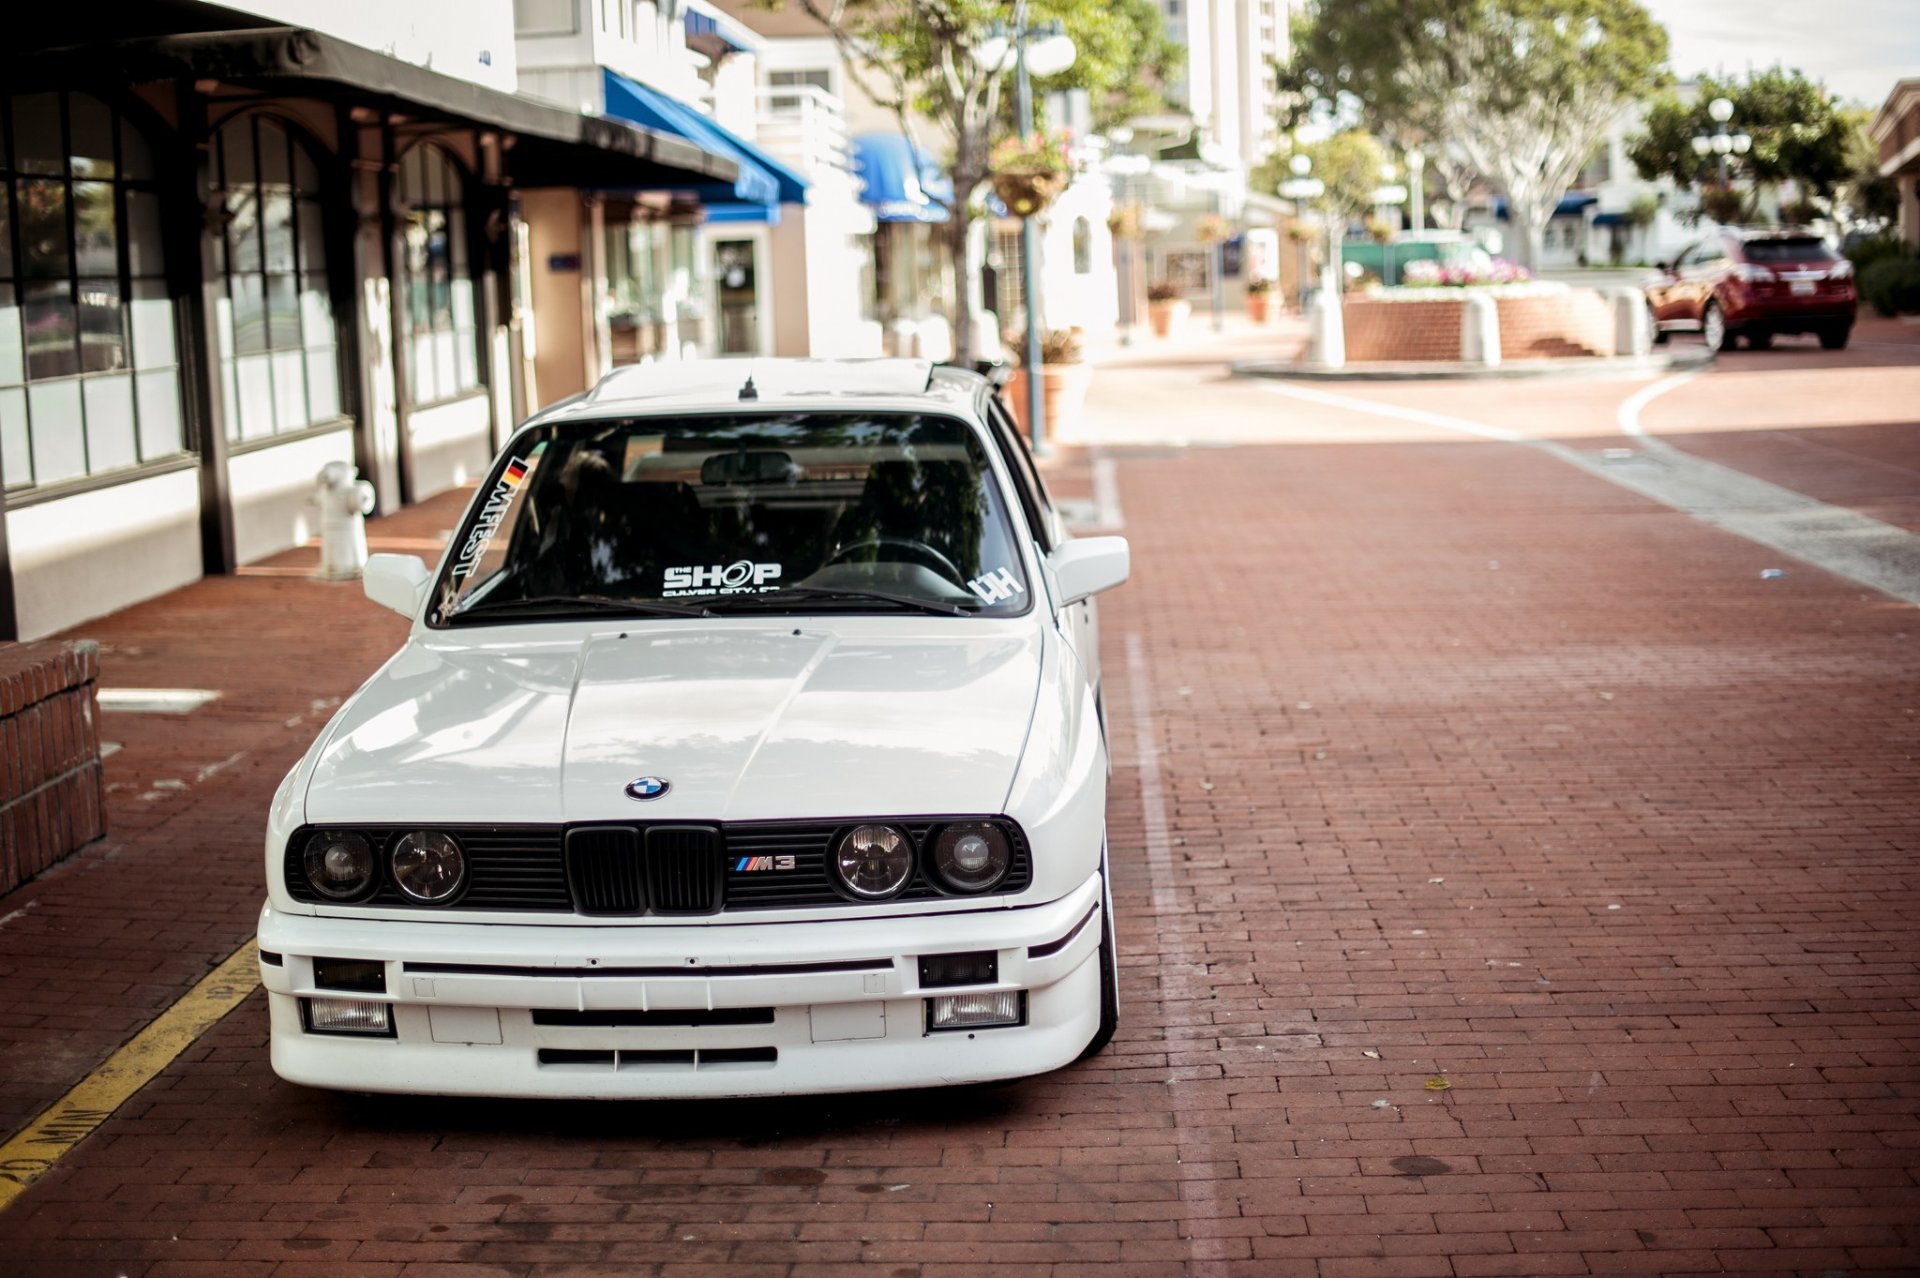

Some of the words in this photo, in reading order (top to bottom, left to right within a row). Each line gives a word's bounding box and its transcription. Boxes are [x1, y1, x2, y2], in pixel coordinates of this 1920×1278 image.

[663, 560, 782, 588] SHOP
[673, 566, 692, 574] THE
[662, 588, 717, 597] CULVER
[750, 855, 796, 871] M3
